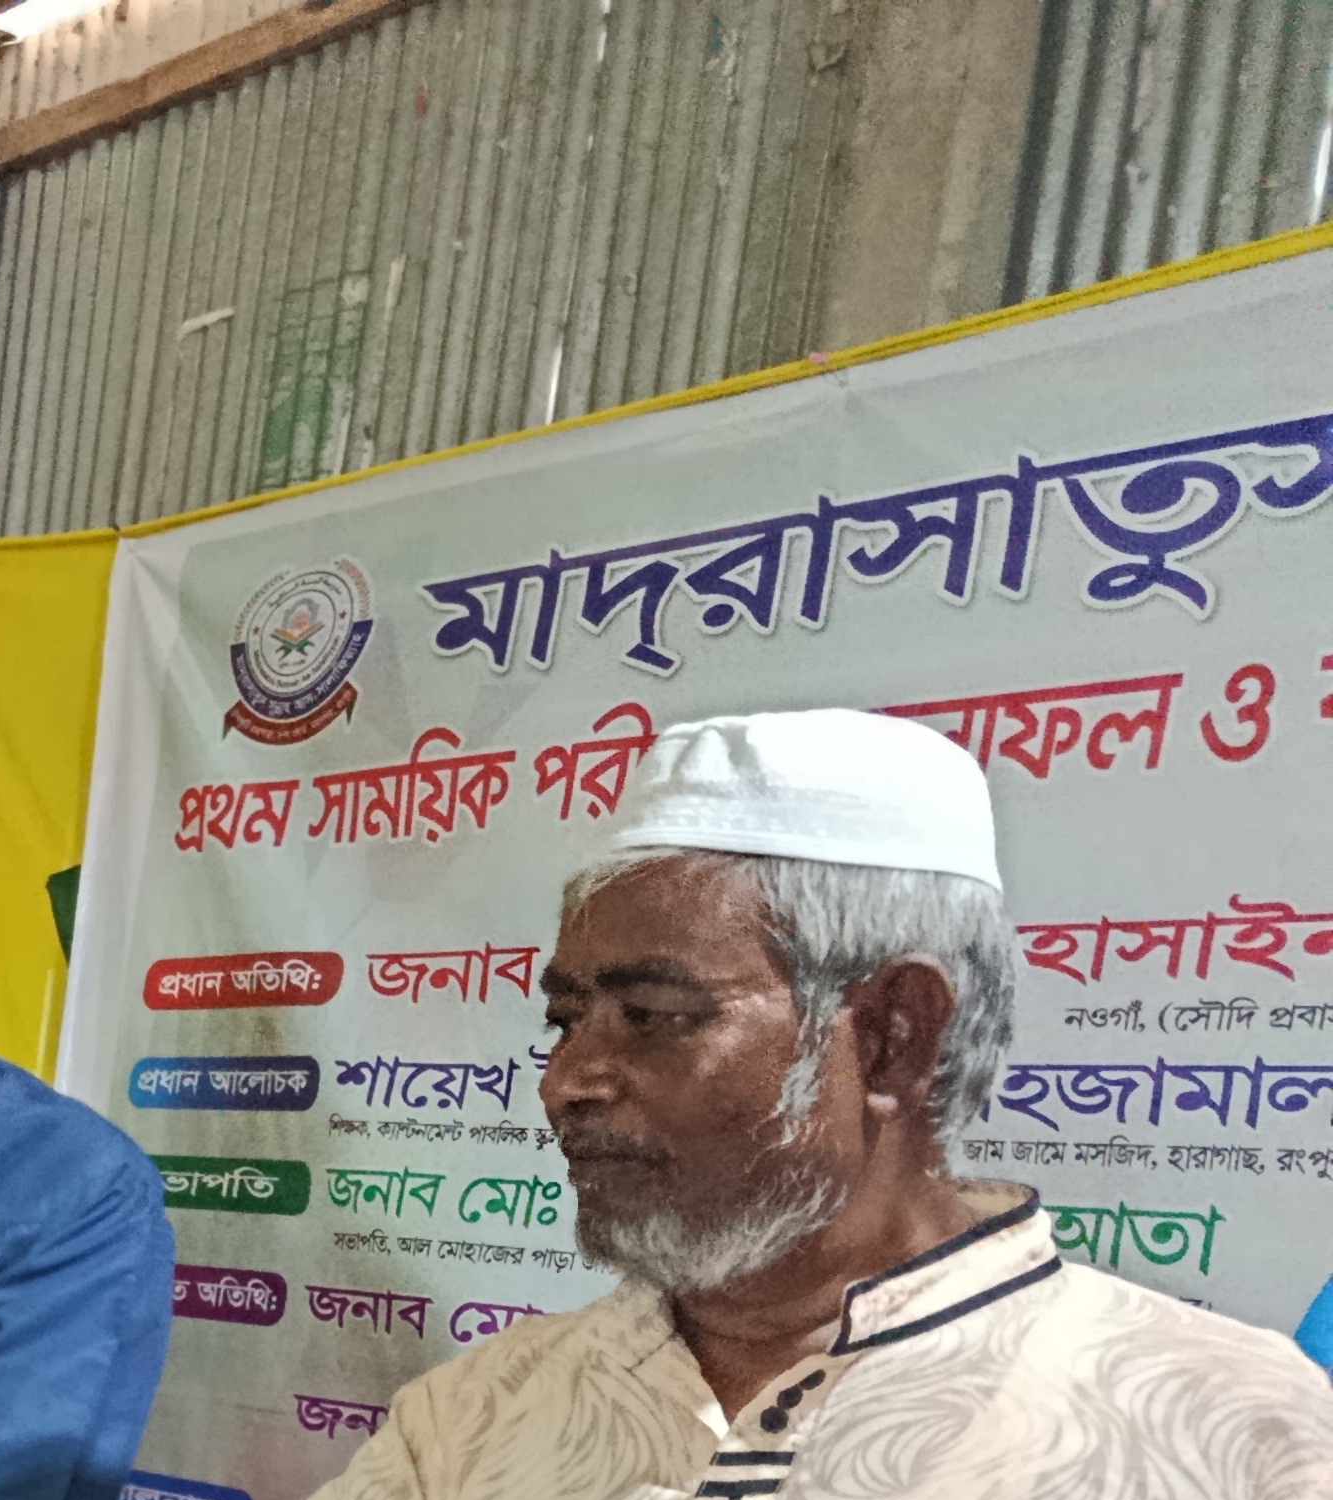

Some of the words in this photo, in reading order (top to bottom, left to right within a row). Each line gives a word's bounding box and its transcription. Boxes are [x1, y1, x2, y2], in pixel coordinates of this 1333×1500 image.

[174, 779, 300, 853] প্রথম
[307, 726, 517, 844] সাময়িক
[534, 702, 660, 821] পরী
[1200, 663, 1277, 762] ও
[157, 970, 223, 999] প্রধান
[365, 942, 542, 1004] জনাব
[1269, 1003, 1333, 1032] প্রবা
[137, 1067, 200, 1097] প্রধান
[208, 1067, 311, 1097] আলোচক
[335, 1055, 521, 1112] শায়েখ
[469, 1120, 530, 1146] পাবলিক
[1011, 1138, 1067, 1166] জামে
[1073, 1134, 1159, 1171] মসজিদ,
[1277, 1146, 1333, 1181] রংপু
[161, 1166, 280, 1199] ভাপতি
[325, 1165, 447, 1218] জনাব
[396, 1236, 434, 1258] আল
[438, 1239, 527, 1266] মোহাজের
[531, 1248, 578, 1274] পাড়া
[304, 1284, 436, 1341] জনাব
[450, 1300, 558, 1343] মো
[293, 1394, 391, 1440] জন
